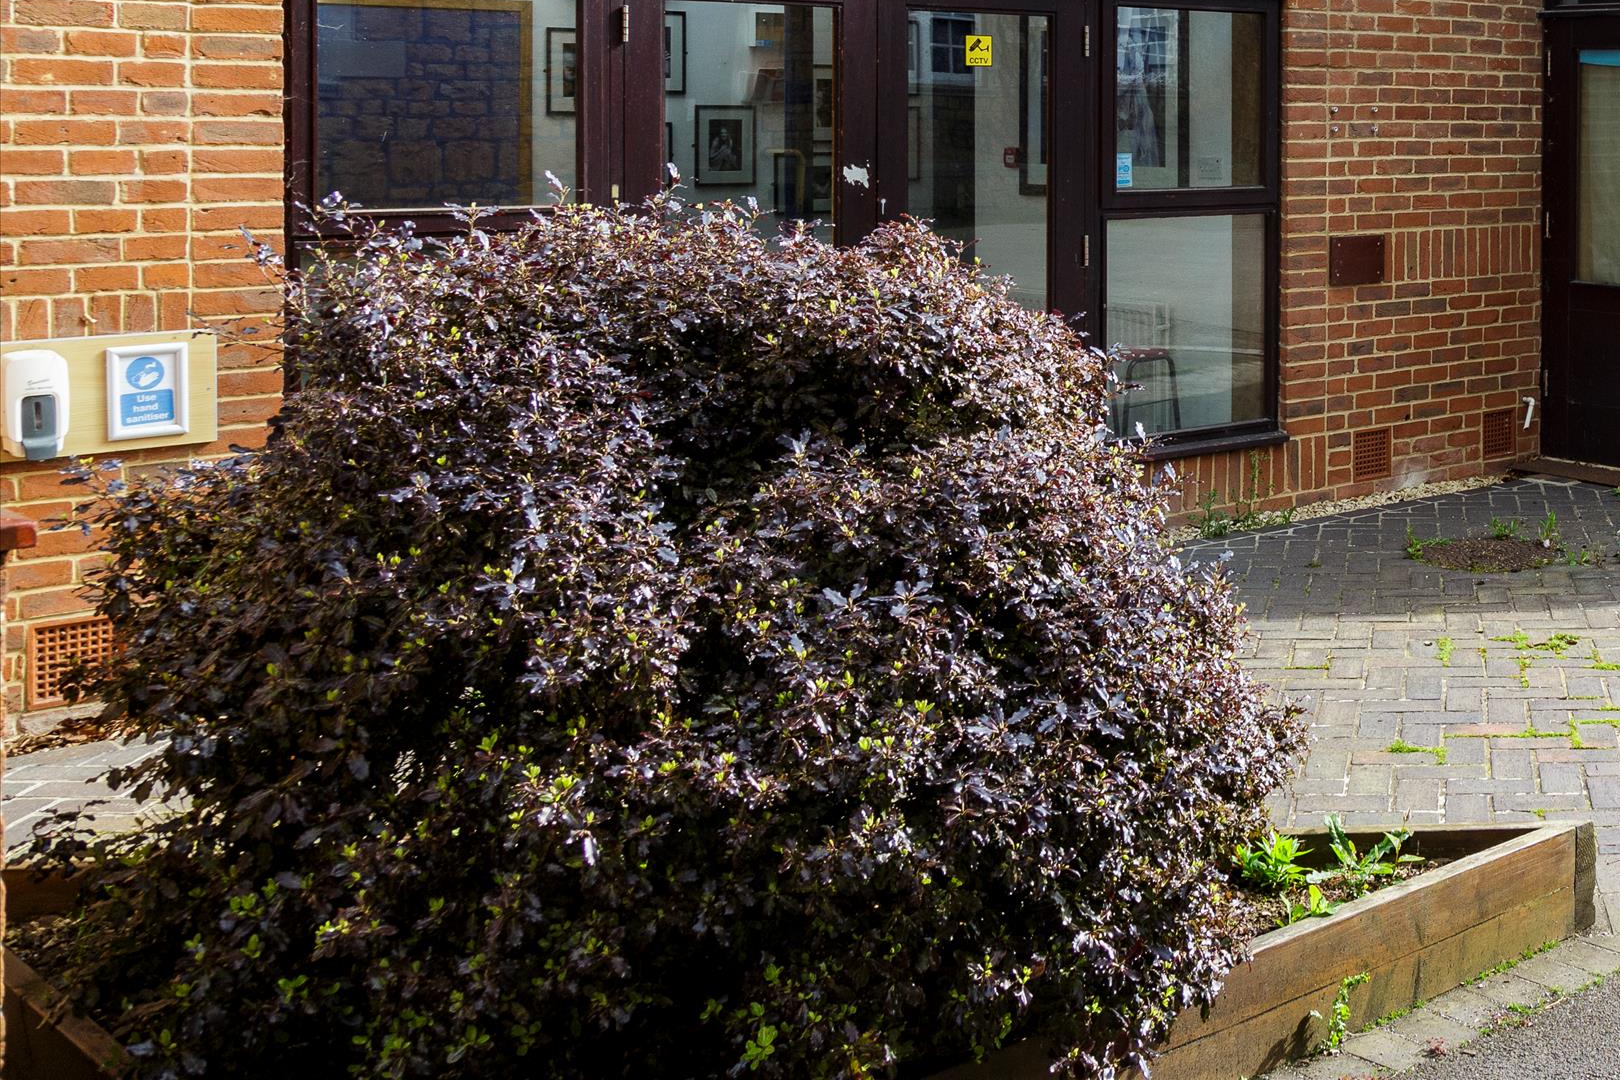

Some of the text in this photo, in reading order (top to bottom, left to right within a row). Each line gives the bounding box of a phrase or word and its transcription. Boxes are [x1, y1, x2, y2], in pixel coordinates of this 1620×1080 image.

[136, 394, 157, 402] Use
[133, 403, 158, 412] hand
[126, 413, 169, 423] sanitiser
